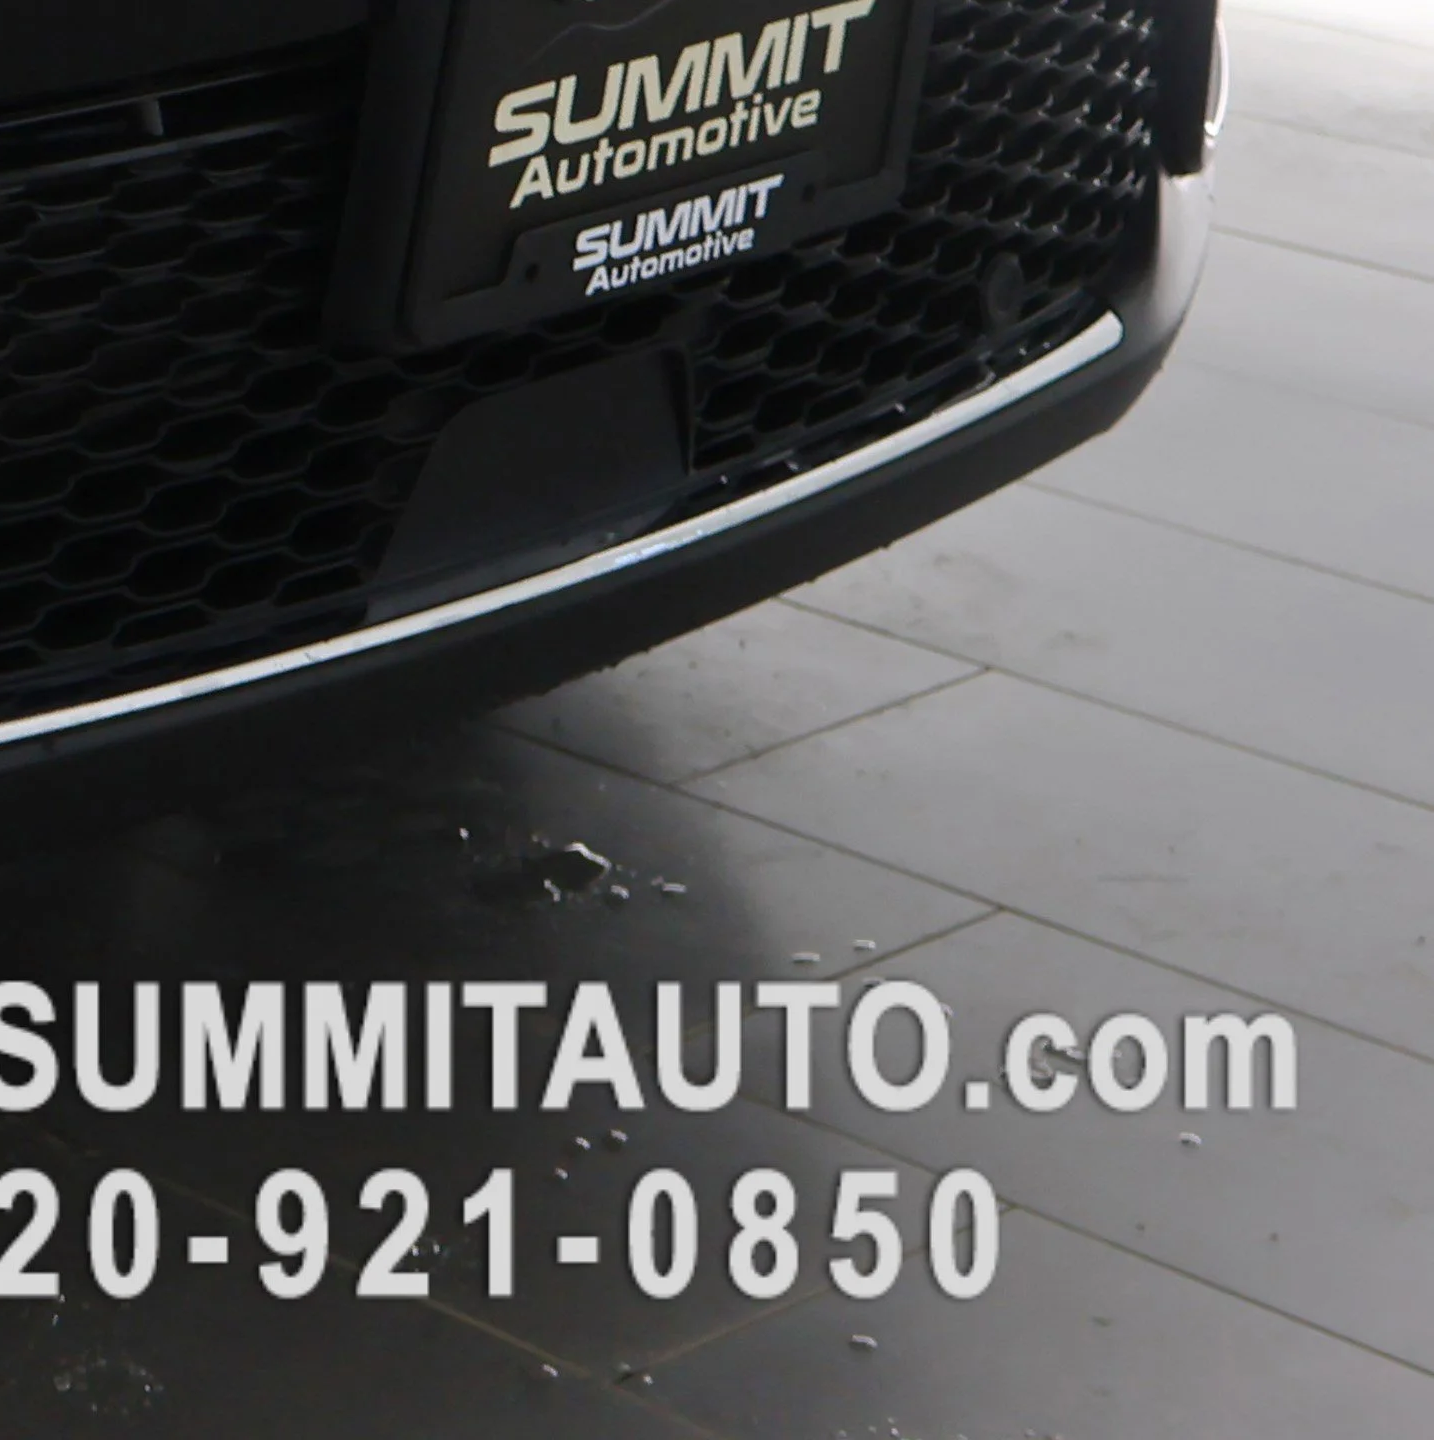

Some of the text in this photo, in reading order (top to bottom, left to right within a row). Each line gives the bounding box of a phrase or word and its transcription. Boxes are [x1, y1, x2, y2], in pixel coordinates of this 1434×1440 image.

[509, 88, 821, 209] Automotive
[573, 175, 784, 271] SUMMIT
[585, 227, 754, 295] Automotive
